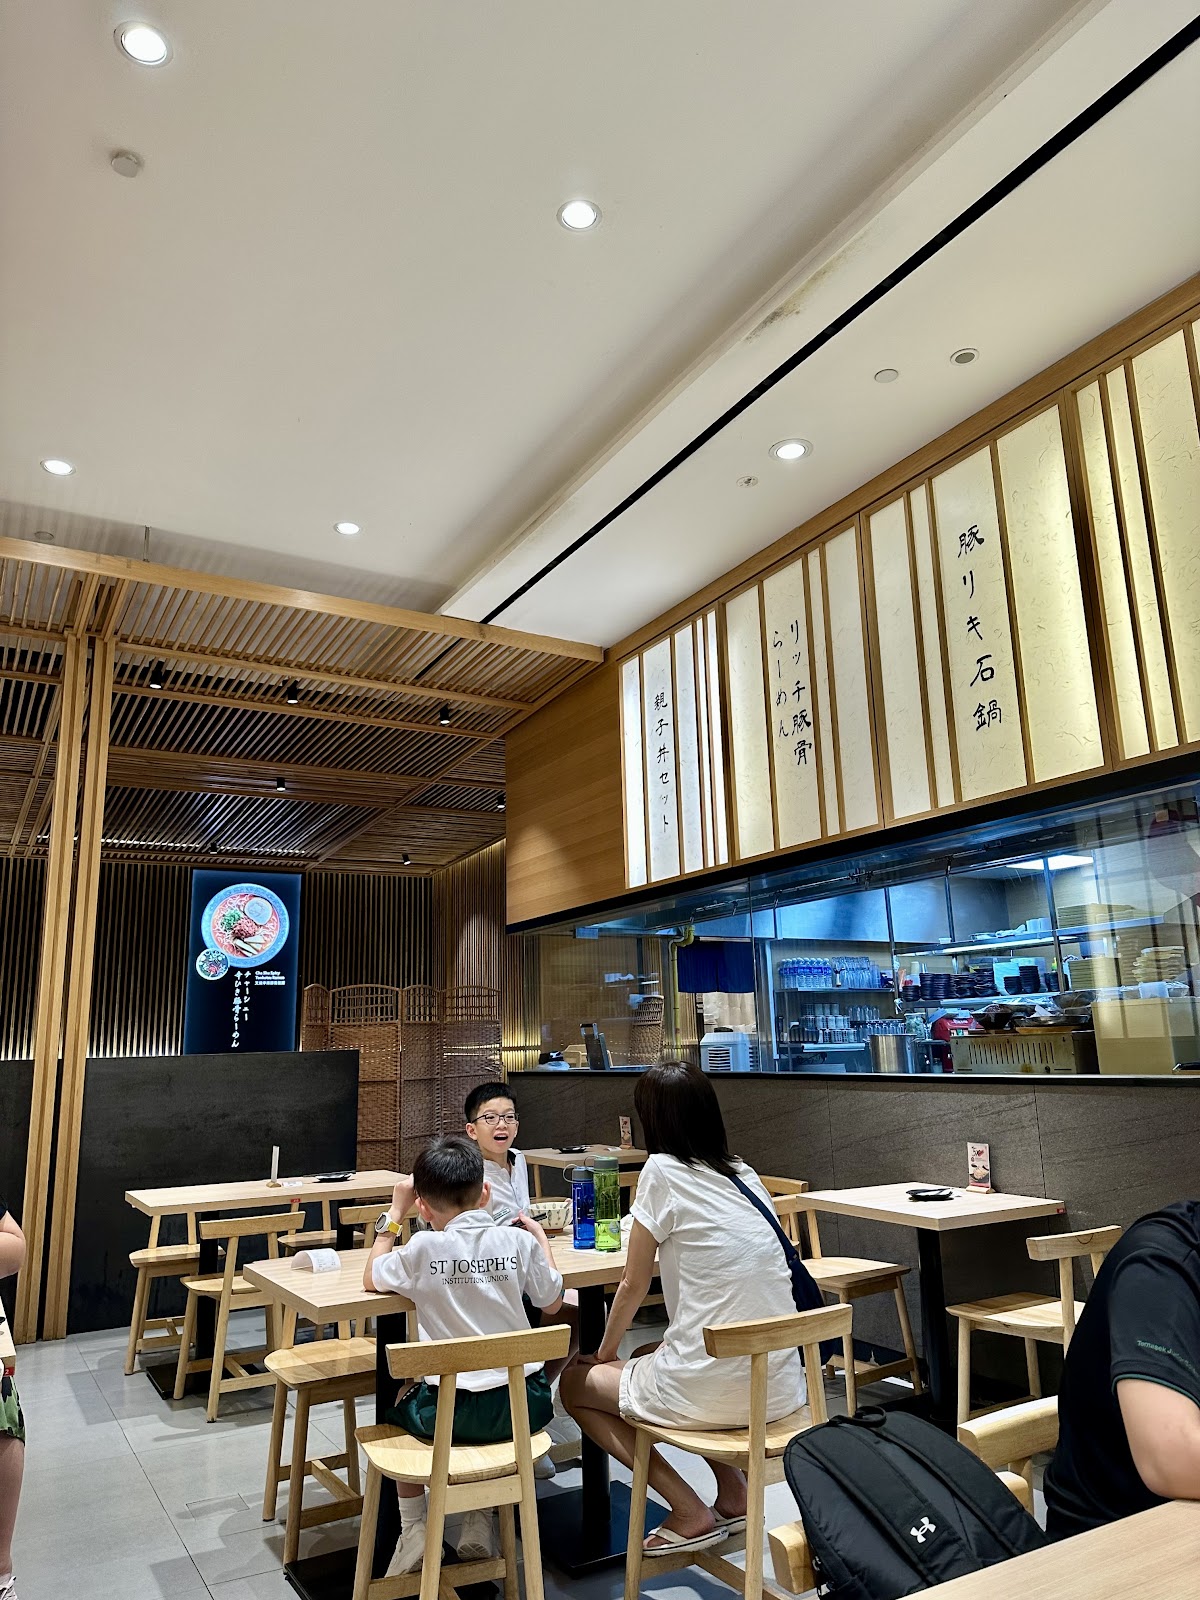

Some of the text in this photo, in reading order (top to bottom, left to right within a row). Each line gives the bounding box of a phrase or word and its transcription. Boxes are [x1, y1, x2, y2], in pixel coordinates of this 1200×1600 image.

[957, 524, 1002, 732] 豚リキ石鍋
[773, 630, 789, 738] らーめん
[791, 619, 812, 766] リッチ豚骨
[429, 1256, 517, 1277] ST JOSEPH'S
[442, 1274, 509, 1285] INSTITUTION JUNIOR
[1137, 1340, 1166, 1353] Temasek
